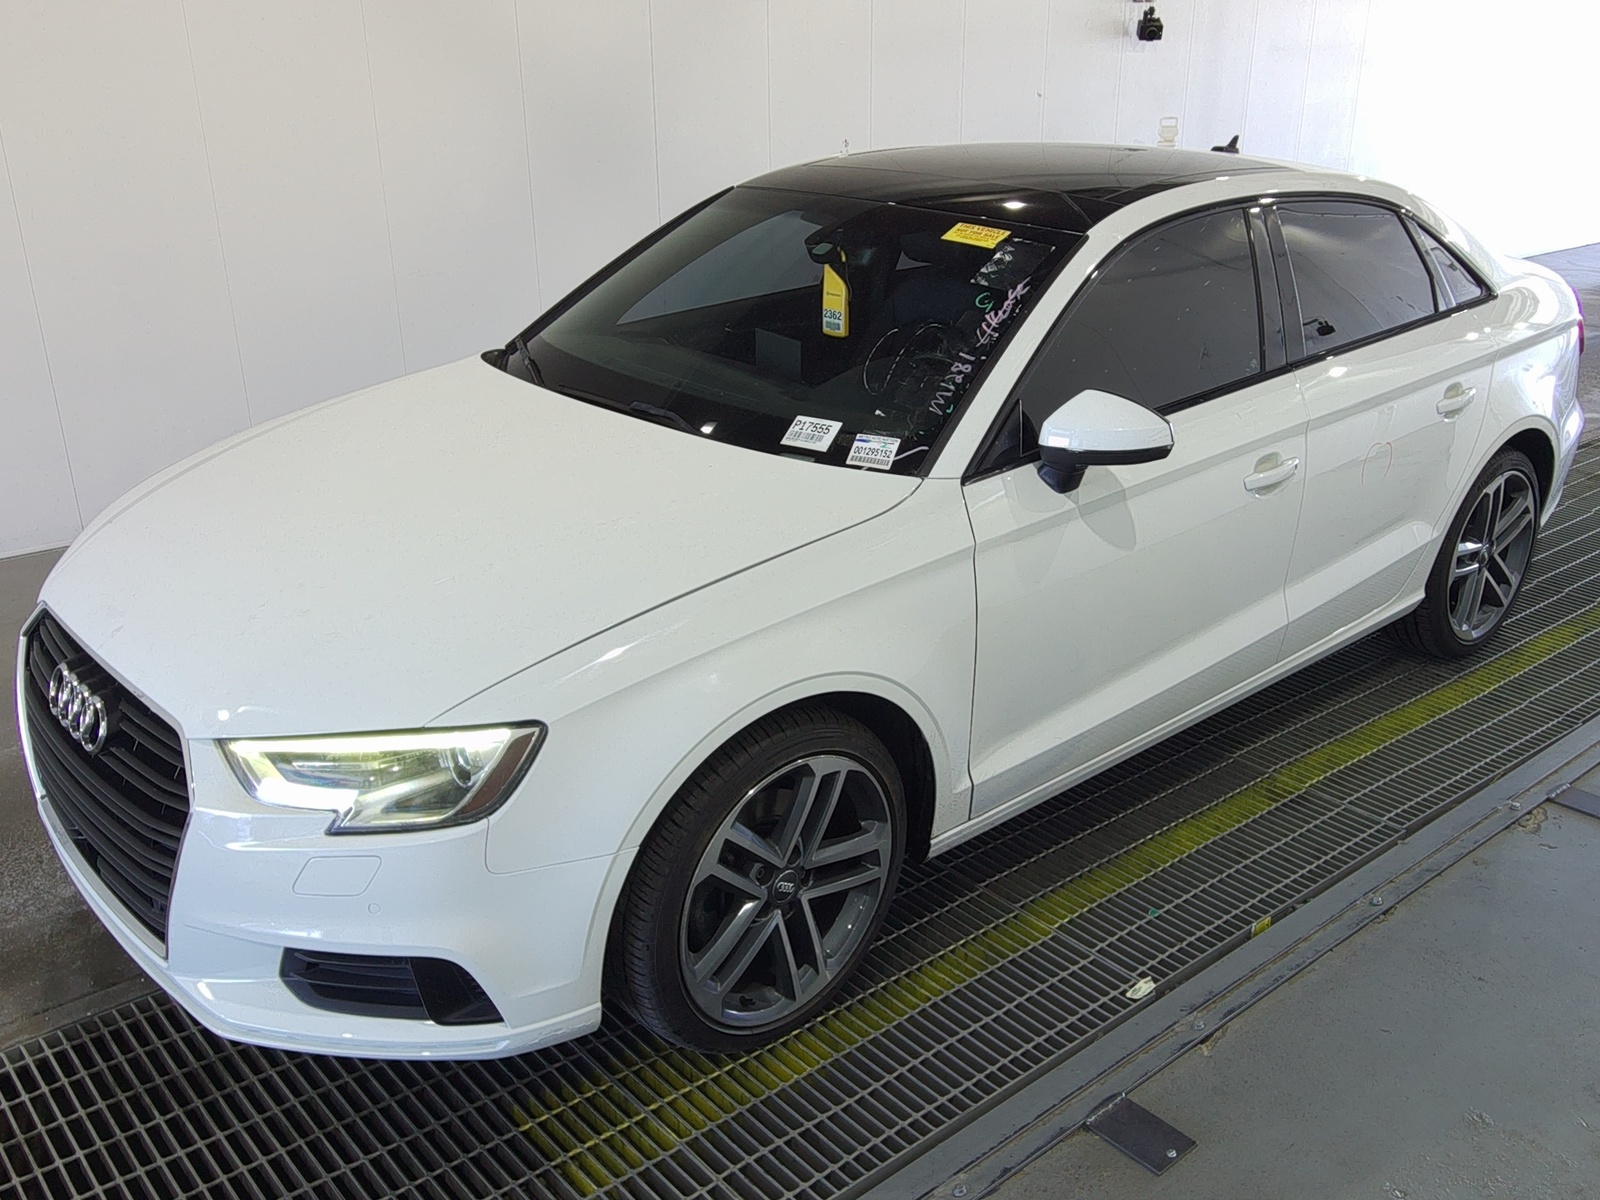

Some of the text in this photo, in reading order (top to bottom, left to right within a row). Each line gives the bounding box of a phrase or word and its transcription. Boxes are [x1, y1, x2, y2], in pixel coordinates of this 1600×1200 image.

[823, 308, 842, 321] 2362
[792, 419, 833, 435] P17555
[853, 445, 893, 459] 001295152
